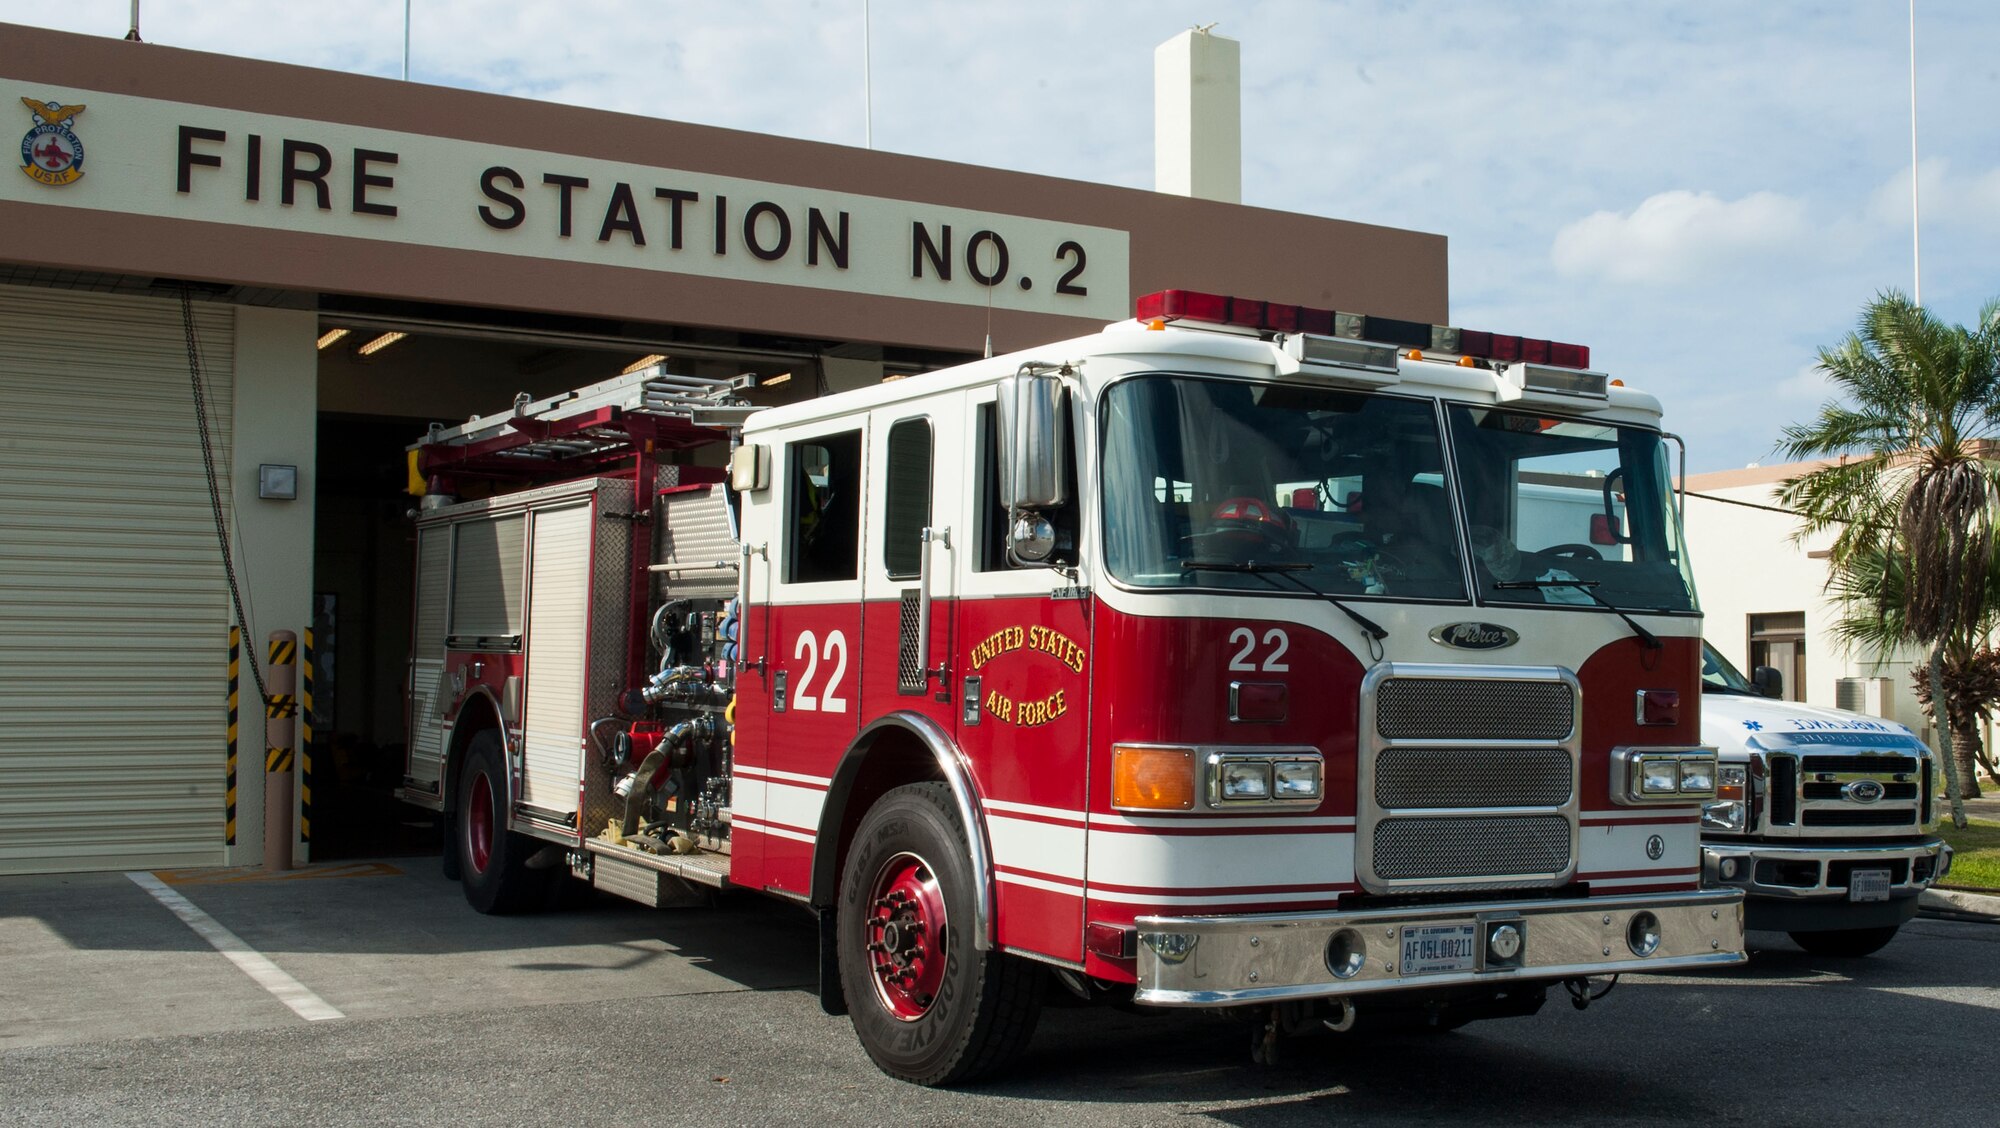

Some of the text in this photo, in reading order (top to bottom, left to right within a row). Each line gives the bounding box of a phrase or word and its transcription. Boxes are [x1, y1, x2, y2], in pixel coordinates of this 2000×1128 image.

[23, 125, 84, 160] FIRE PROTECTION
[33, 168, 70, 184] USAF
[176, 124, 1088, 297] FIRE STATION NO. 2
[970, 625, 1086, 674] UNITED STATES
[1228, 627, 1289, 672] 22
[1450, 623, 1500, 645] Pierce
[793, 629, 848, 713] 22
[985, 689, 1067, 726] AIR FORCE
[1859, 784, 1877, 796] Ford
[1404, 938, 1472, 960] AF05L00211
